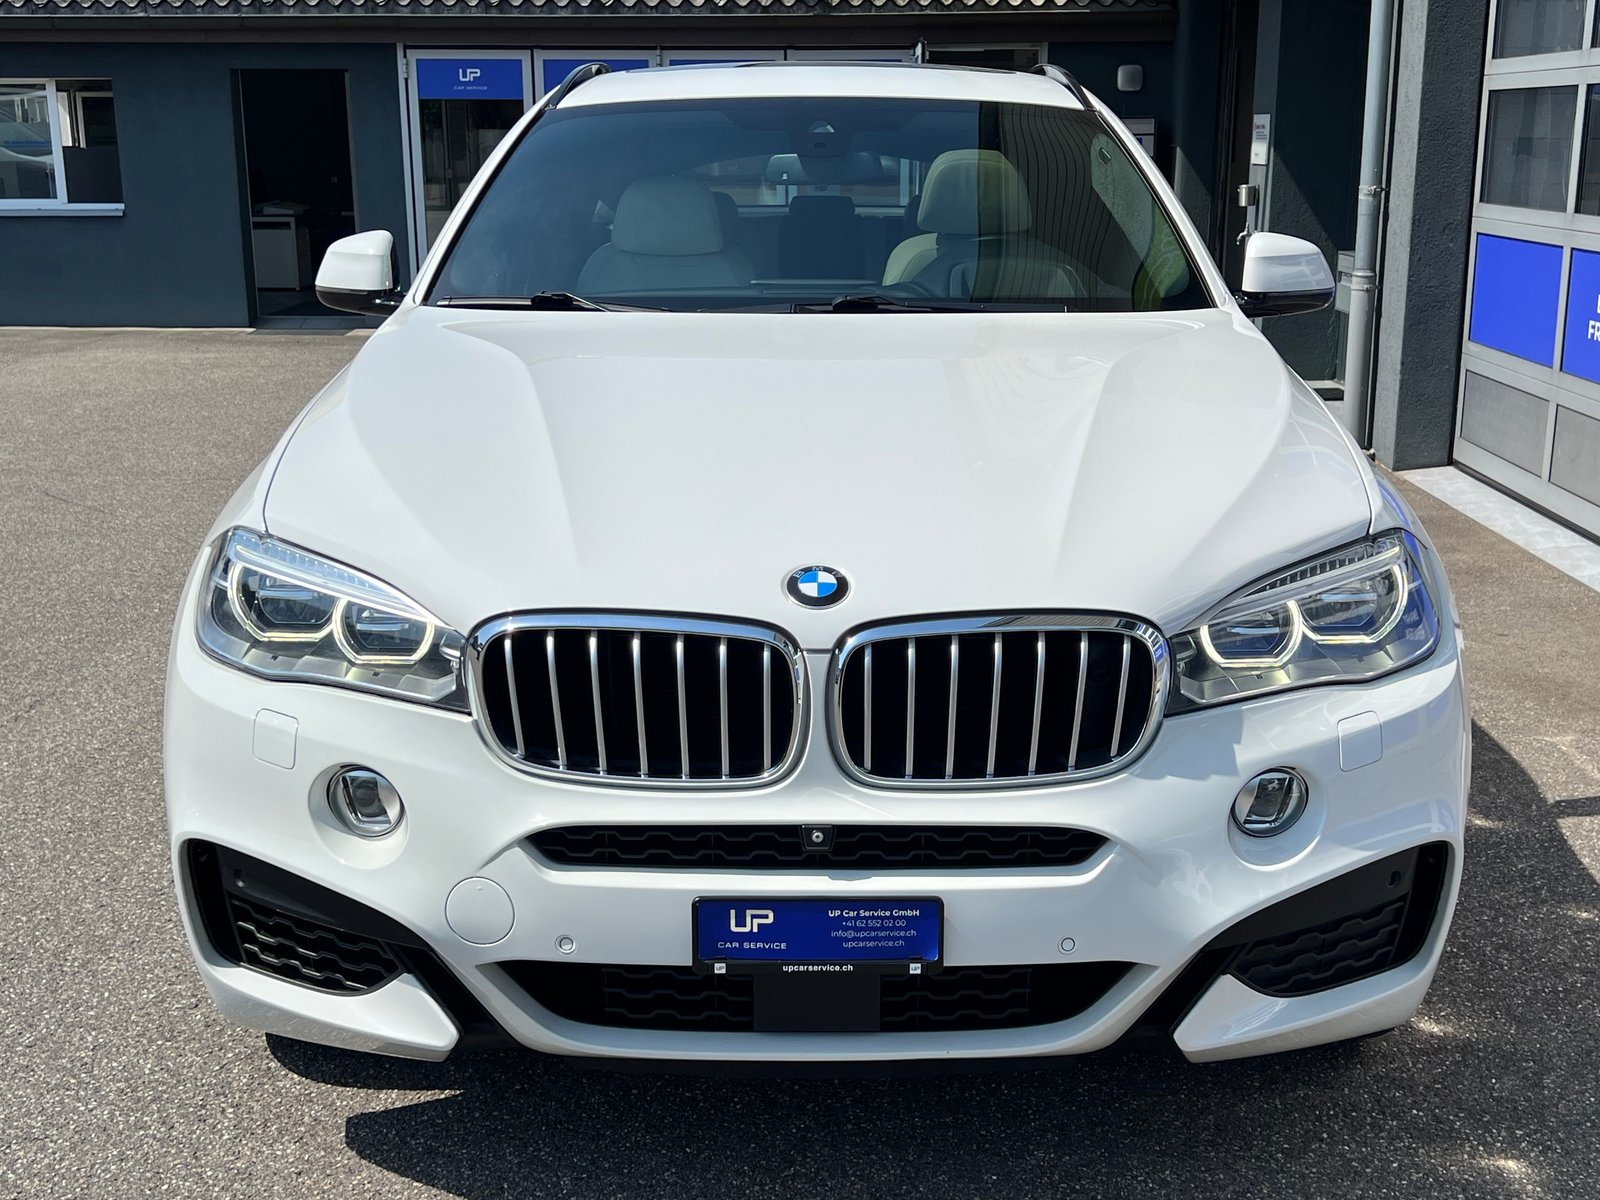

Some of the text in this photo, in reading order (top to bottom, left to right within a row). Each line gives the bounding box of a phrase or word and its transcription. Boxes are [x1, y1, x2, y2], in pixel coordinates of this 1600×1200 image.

[459, 68, 481, 81] UP
[793, 566, 844, 578] BMW
[859, 909, 891, 917] Service
[892, 909, 920, 917] GmbH
[730, 909, 774, 933] UP
[831, 929, 917, 938] info@upcarservice.ch
[717, 941, 787, 950] CAR SERVICE
[842, 940, 905, 948] upcarservice.ch
[782, 964, 854, 972] upcarservice.ch
